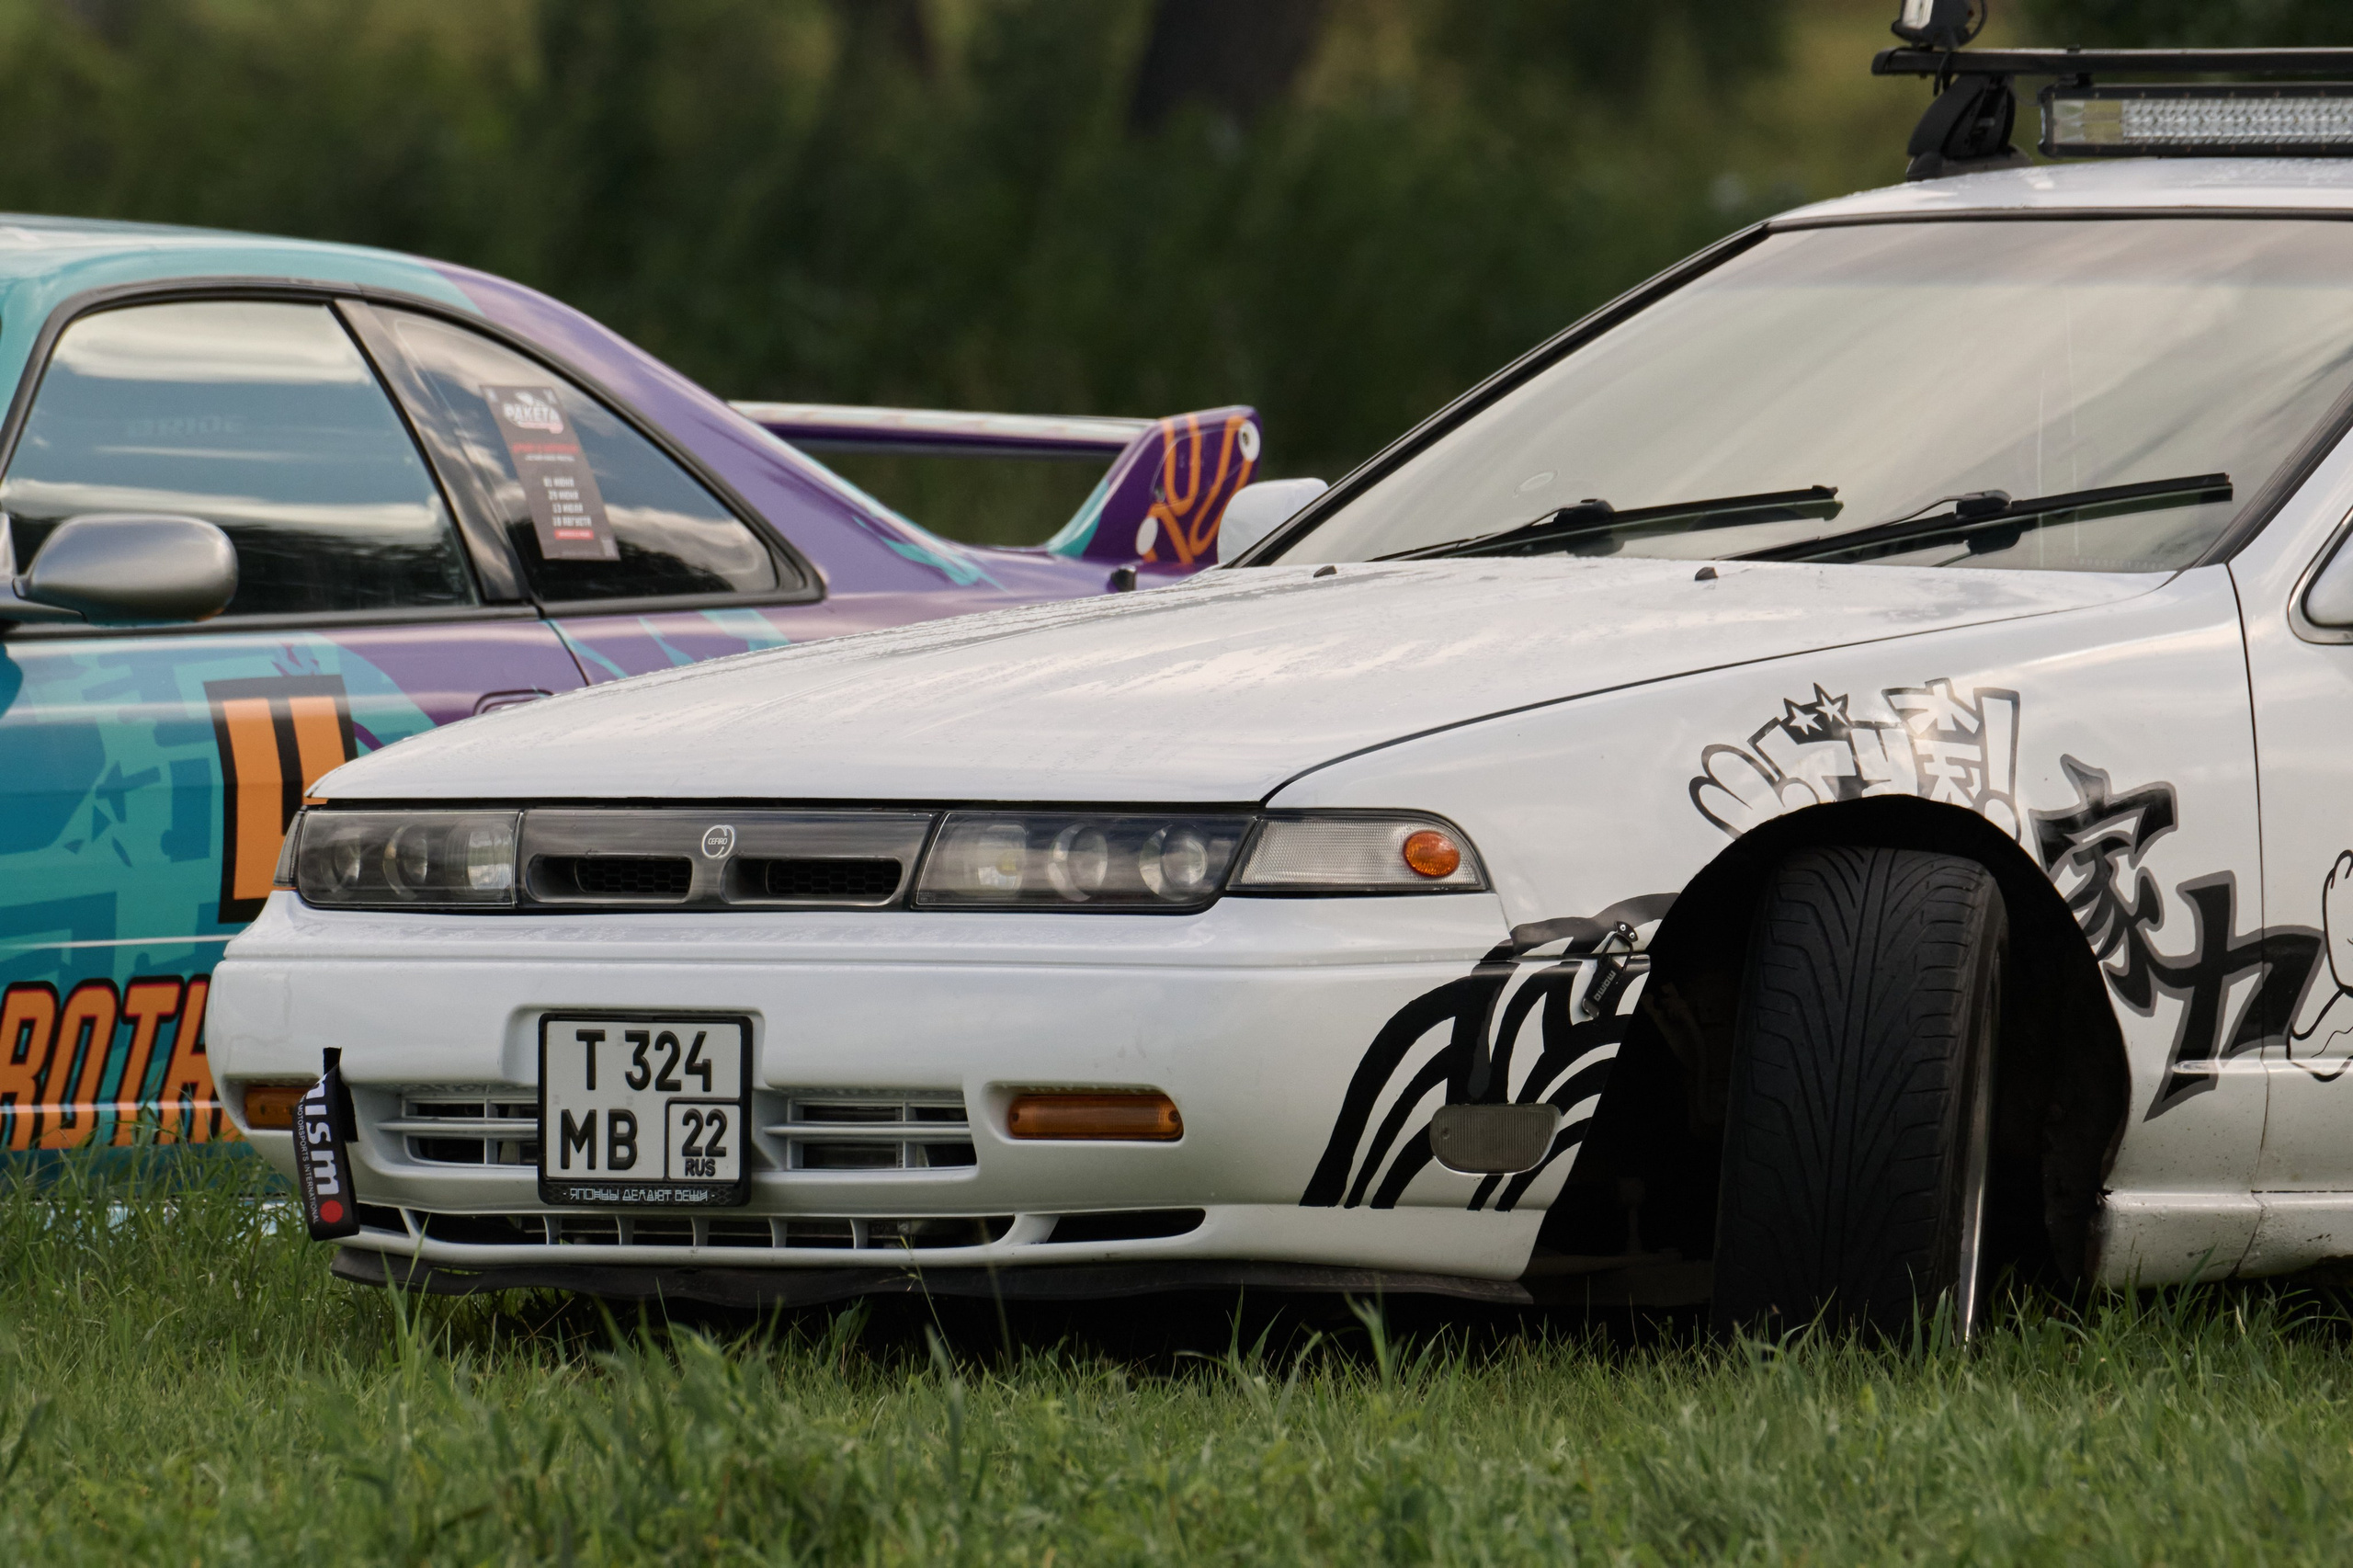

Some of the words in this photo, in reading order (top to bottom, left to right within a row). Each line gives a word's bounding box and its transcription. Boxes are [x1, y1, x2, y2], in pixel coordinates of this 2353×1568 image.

[708, 837, 727, 846] CEFIRO
[575, 1029, 606, 1091] T
[624, 1029, 712, 1093] 324
[560, 1108, 638, 1171] MB
[681, 1108, 728, 1158] 22
[684, 1158, 716, 1177] RUS
